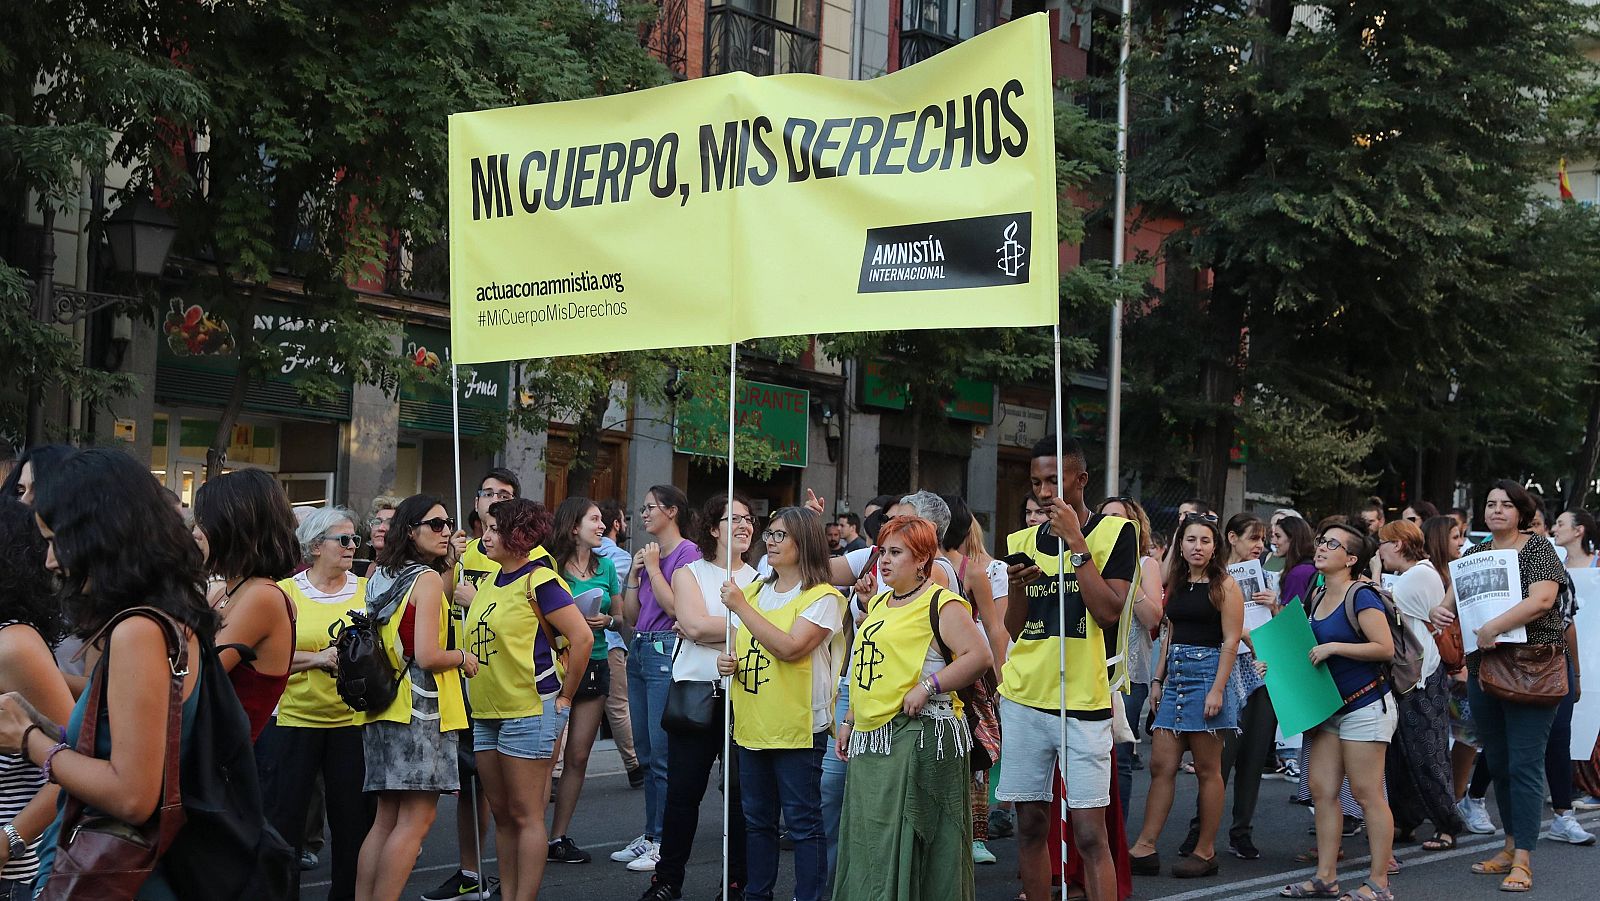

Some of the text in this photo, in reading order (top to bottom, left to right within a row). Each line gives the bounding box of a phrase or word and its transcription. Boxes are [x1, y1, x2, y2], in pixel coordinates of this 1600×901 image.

[471, 79, 1029, 221] MI CUERPO, MIS DERECHOS
[871, 235, 945, 266] AMNISTÍA
[476, 270, 625, 302] actuaconamnistia.org
[868, 265, 946, 282] INTERNACIONAL
[477, 299, 628, 327] #MiCuerpoMisDerechos
[1457, 555, 1494, 570] SOCIALISMO
[1025, 584, 1048, 598] 100%
